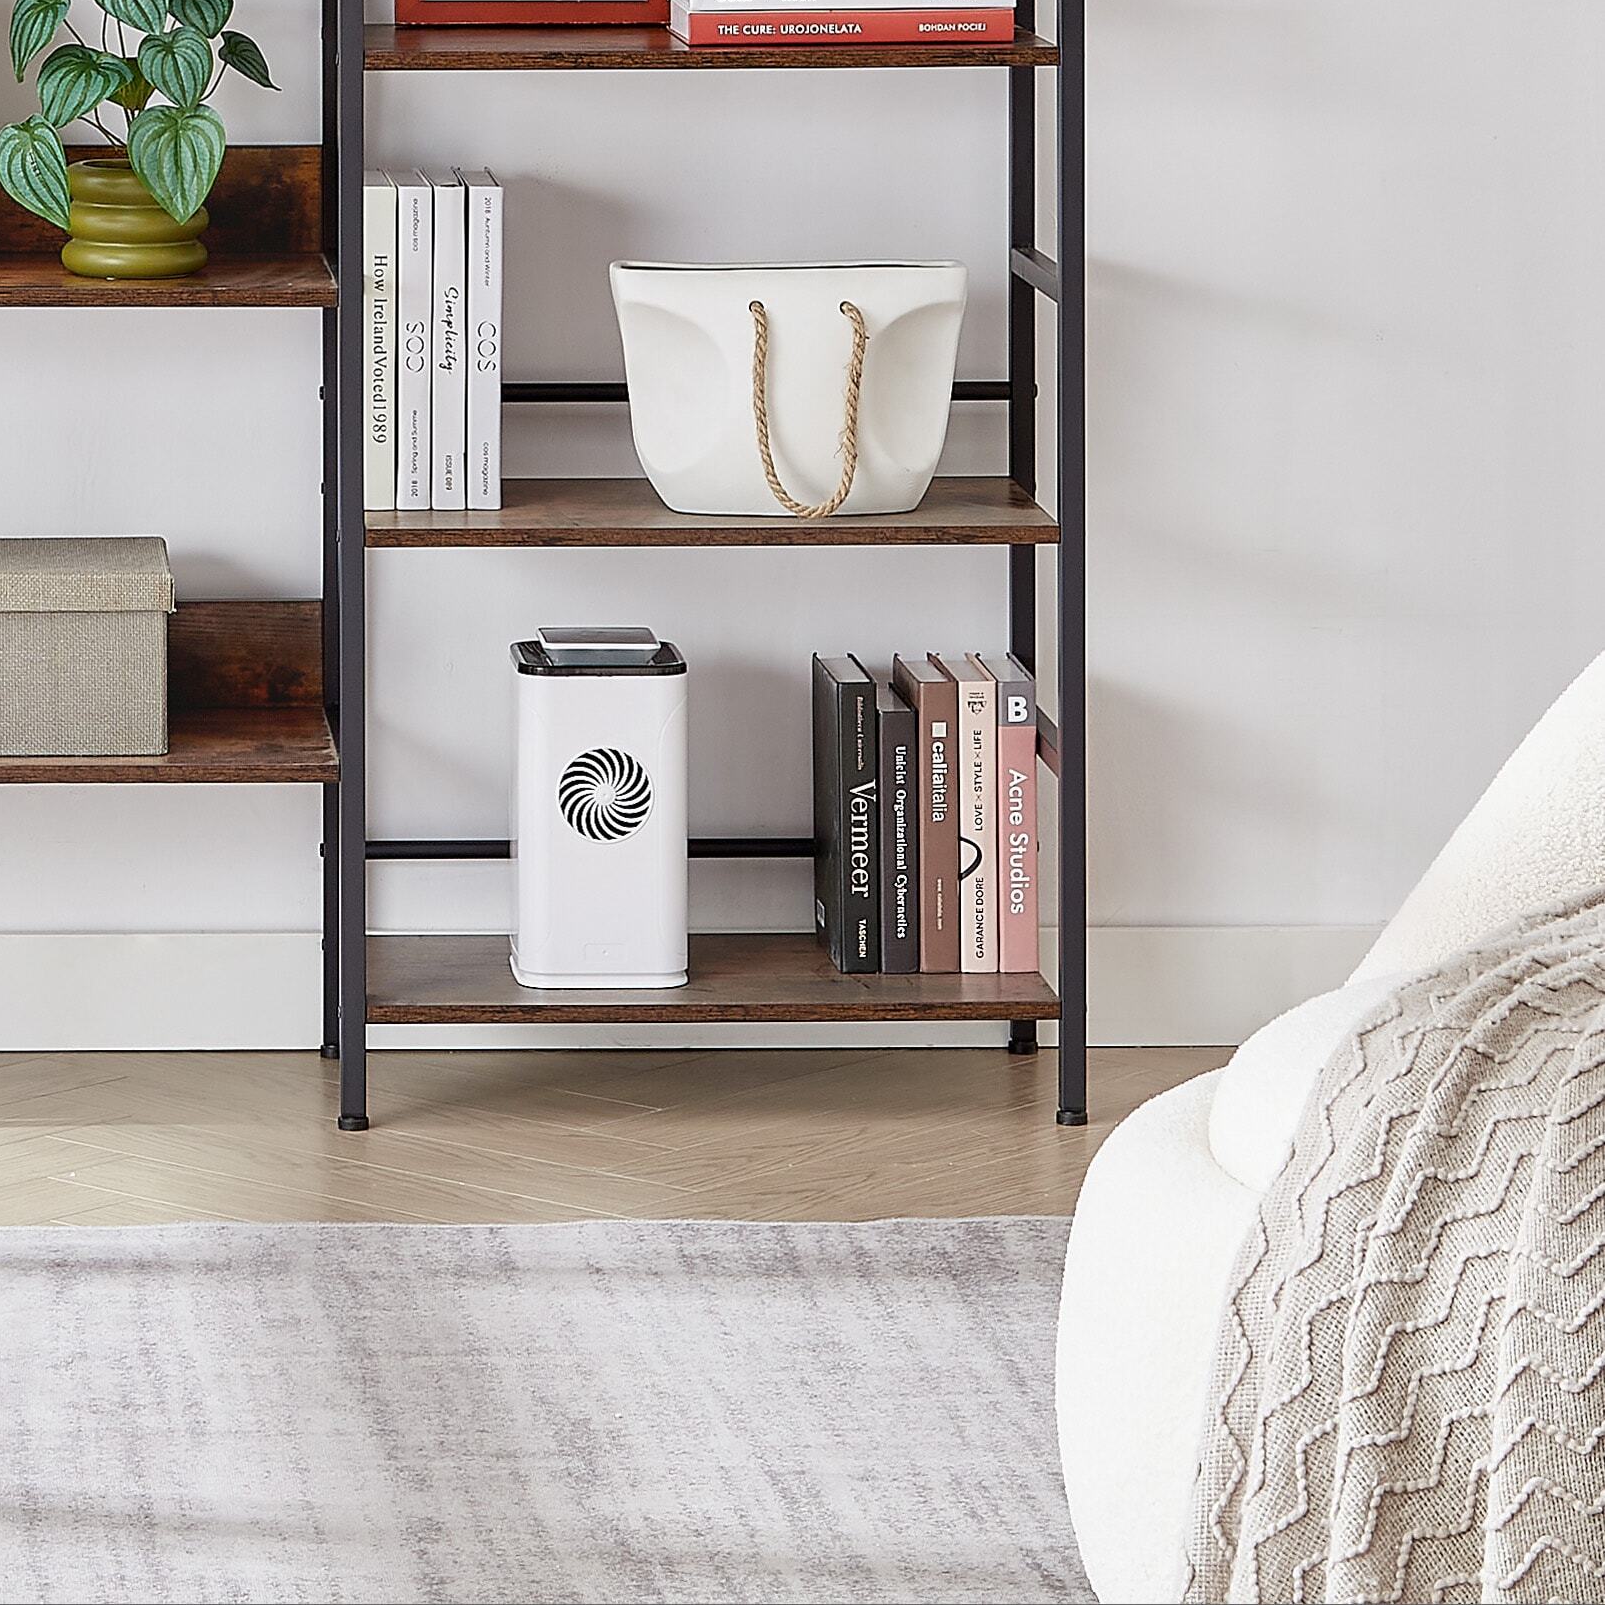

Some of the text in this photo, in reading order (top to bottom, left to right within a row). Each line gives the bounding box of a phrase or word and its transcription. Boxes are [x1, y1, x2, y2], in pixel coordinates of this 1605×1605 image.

[717, 23, 862, 35] THE CURE: UROJONELATA
[918, 23, 955, 33] BOHDAN
[412, 198, 420, 237] magazine
[373, 254, 388, 292] How
[405, 320, 425, 373] COS
[438, 286, 460, 374] Simplicity
[477, 320, 497, 373] COS
[411, 451, 419, 474] Spring
[445, 454, 453, 476] ISSUE
[481, 456, 489, 496] magazine
[1007, 695, 1028, 723] B
[973, 729, 982, 750] LIFE
[931, 741, 948, 823] caliaitalia
[973, 761, 982, 792] STYLE
[974, 803, 983, 831] LOVE
[849, 779, 878, 899] Vermeer
[893, 746, 908, 940] Unicist Organizational Cybernetics
[1008, 768, 1032, 915] Acne Studios
[975, 877, 985, 959] GARANCE DORE
[857, 918, 867, 959] TASCHEN
